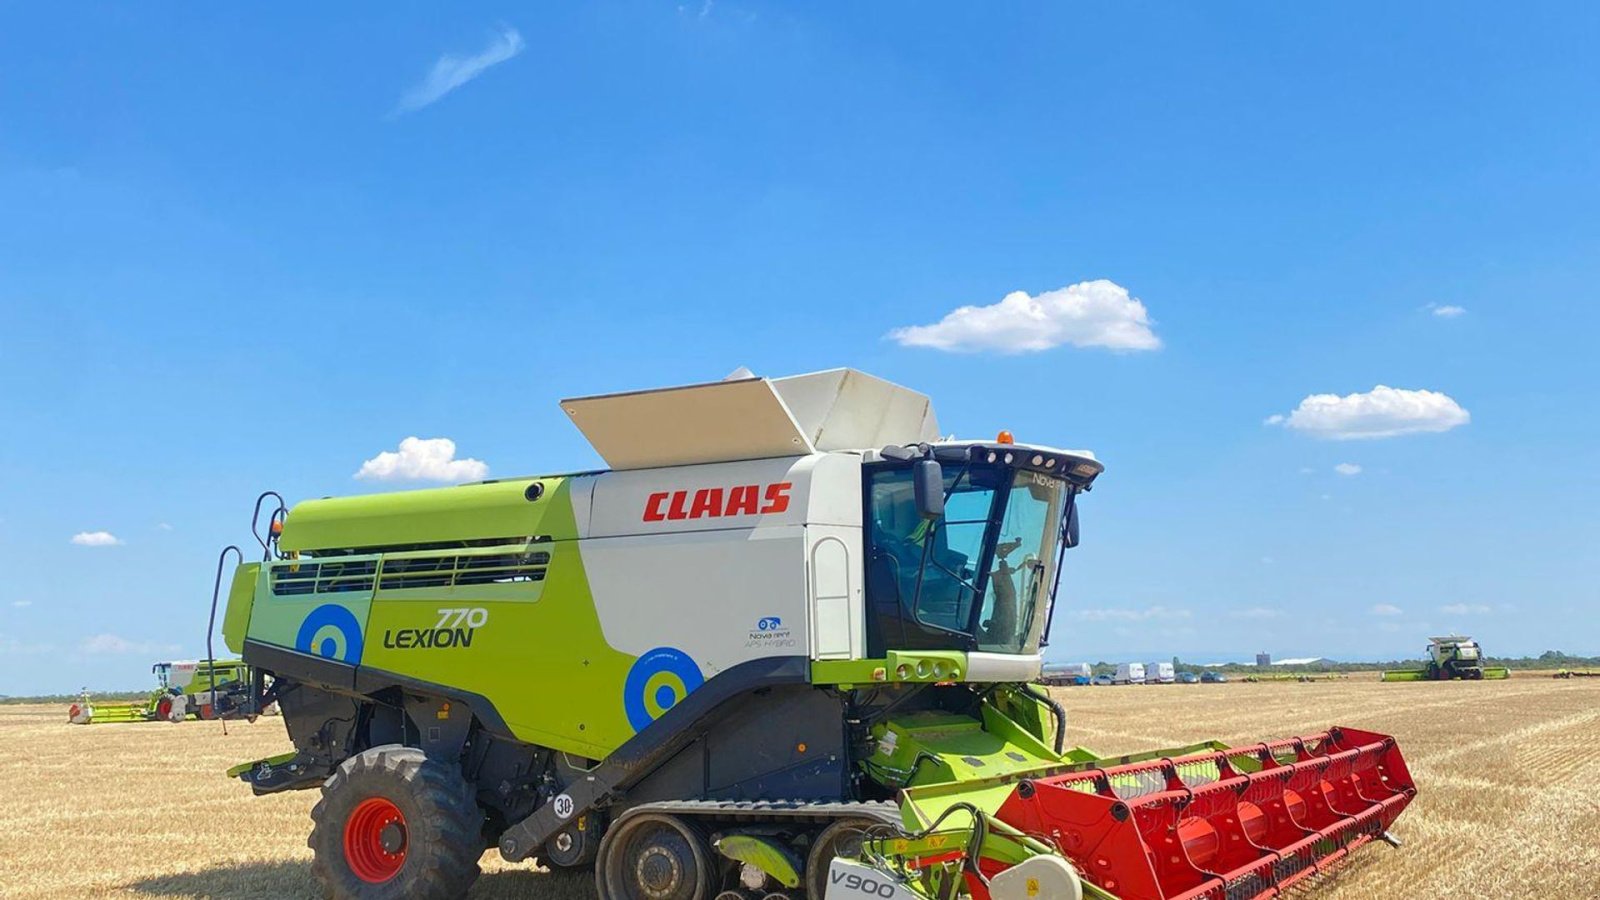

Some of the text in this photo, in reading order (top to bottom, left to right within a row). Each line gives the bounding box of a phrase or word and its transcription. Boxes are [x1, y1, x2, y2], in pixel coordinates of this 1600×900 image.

[642, 482, 793, 522] CLAAS
[435, 607, 488, 629] 770
[383, 628, 474, 649] LEXION
[557, 798, 571, 815] 30
[831, 869, 895, 899] V900
